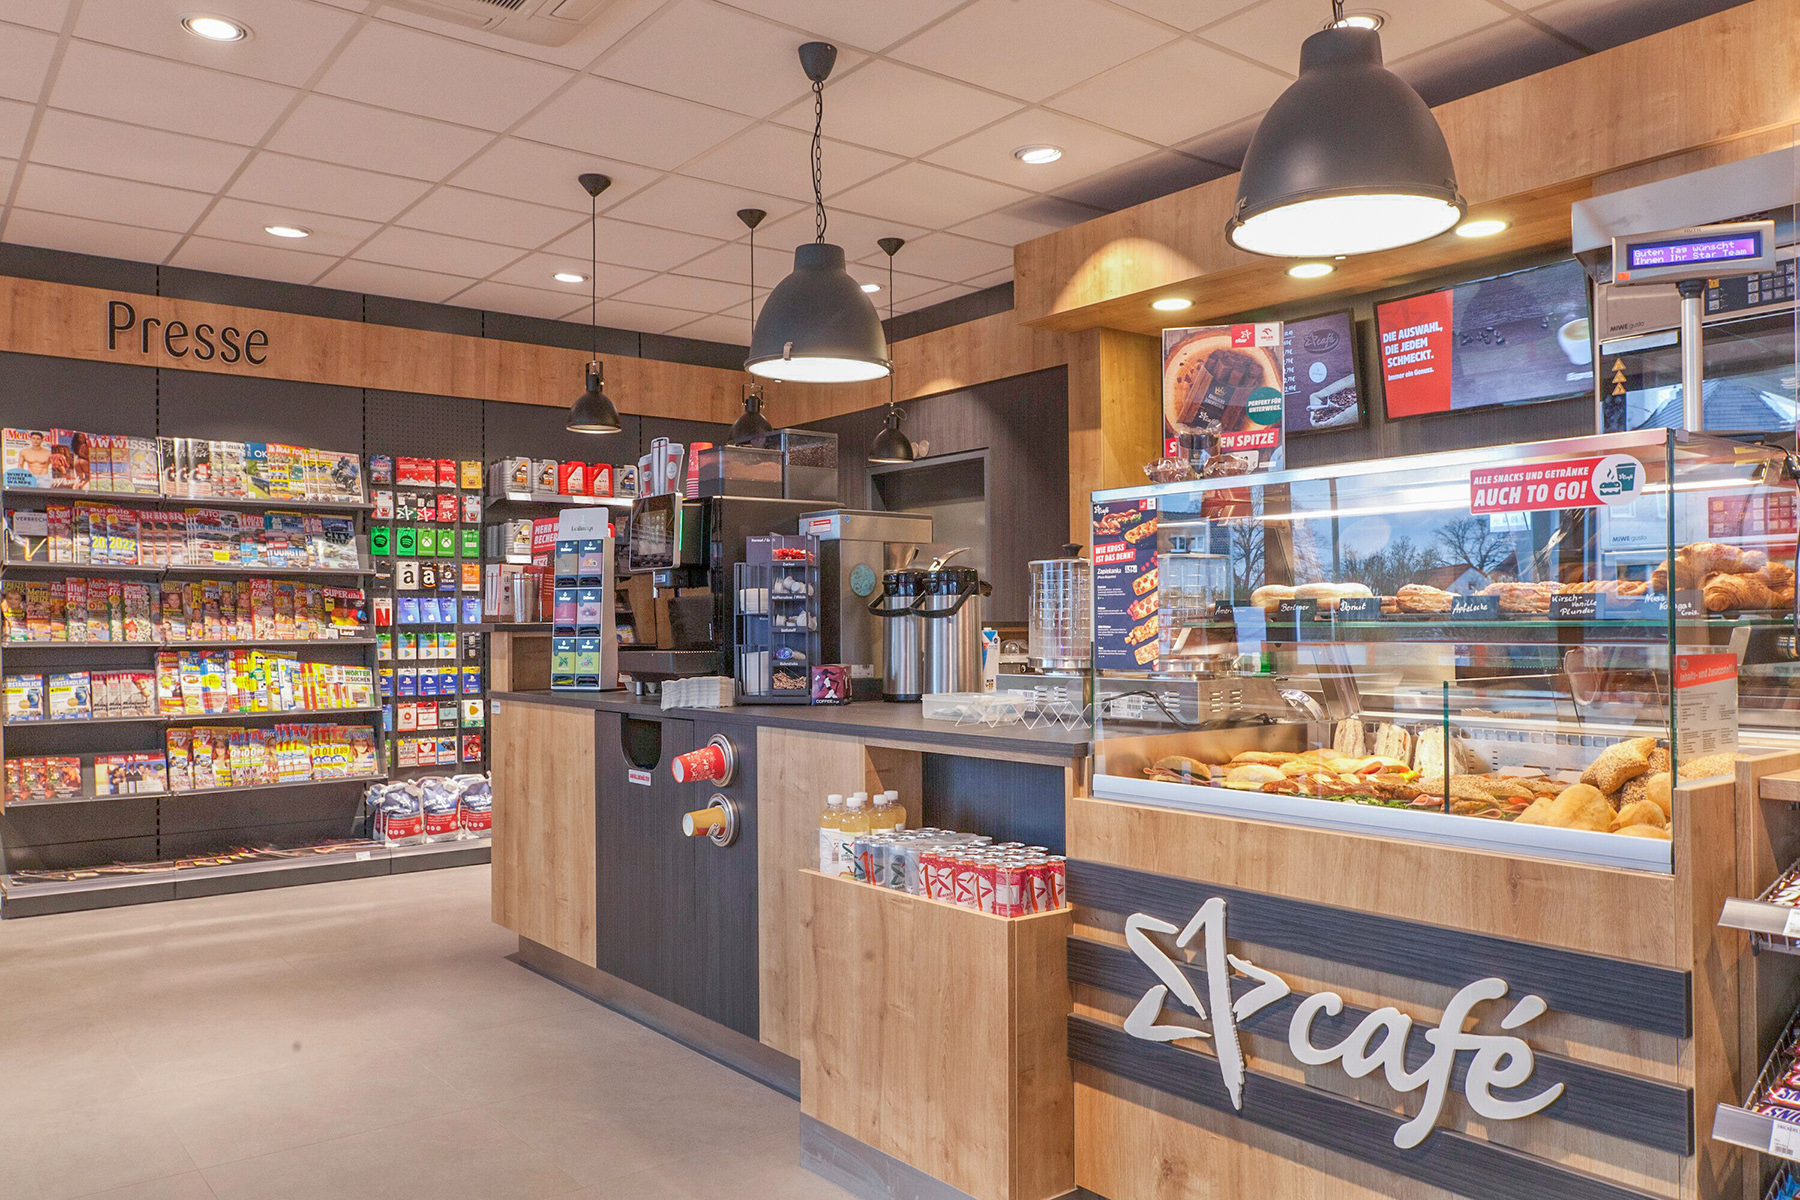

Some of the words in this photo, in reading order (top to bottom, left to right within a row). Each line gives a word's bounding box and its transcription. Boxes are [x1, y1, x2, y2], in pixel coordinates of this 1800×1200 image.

[1634, 249, 1664, 258] Guten
[1670, 247, 1687, 255] Tag
[1692, 241, 1735, 252] wünscht
[1635, 256, 1664, 265] Ihnen
[1670, 254, 1687, 262] Ihr
[1692, 251, 1717, 260] Star
[1723, 248, 1747, 257] Team
[108, 300, 269, 366] Presse
[1382, 331, 1397, 343] DIE
[1398, 321, 1443, 340] AUSWAHL,
[1610, 323, 1628, 332] MIWE
[1629, 321, 1645, 329] gusto
[1385, 343, 1399, 355] DIE
[1400, 337, 1428, 352] JEDEM
[1387, 349, 1435, 368] SCHMECKT.
[1248, 398, 1270, 406] PERFEKT
[1271, 397, 1282, 405] FÜR
[1248, 405, 1282, 413] UNTERWEGS.
[1236, 432, 1275, 447] SPITZE
[1473, 474, 1492, 485] ALLE
[1493, 471, 1524, 483] SNACKS
[1525, 469, 1543, 480] UND
[1544, 466, 1590, 479] GETRÄNKE
[1473, 485, 1521, 507] AUCH
[1527, 483, 1549, 503] TO
[1553, 480, 1588, 501] GO!
[535, 523, 553, 535] MEHR
[109, 536, 137, 551] 2022
[1095, 546, 1106, 554] WIE
[1107, 544, 1125, 553] KROSS
[1095, 555, 1105, 563] IST
[1104, 553, 1115, 562] DAS
[323, 588, 347, 598] SUPER
[1659, 601, 1692, 611] Nogat
[1288, 977, 1565, 1149] café
